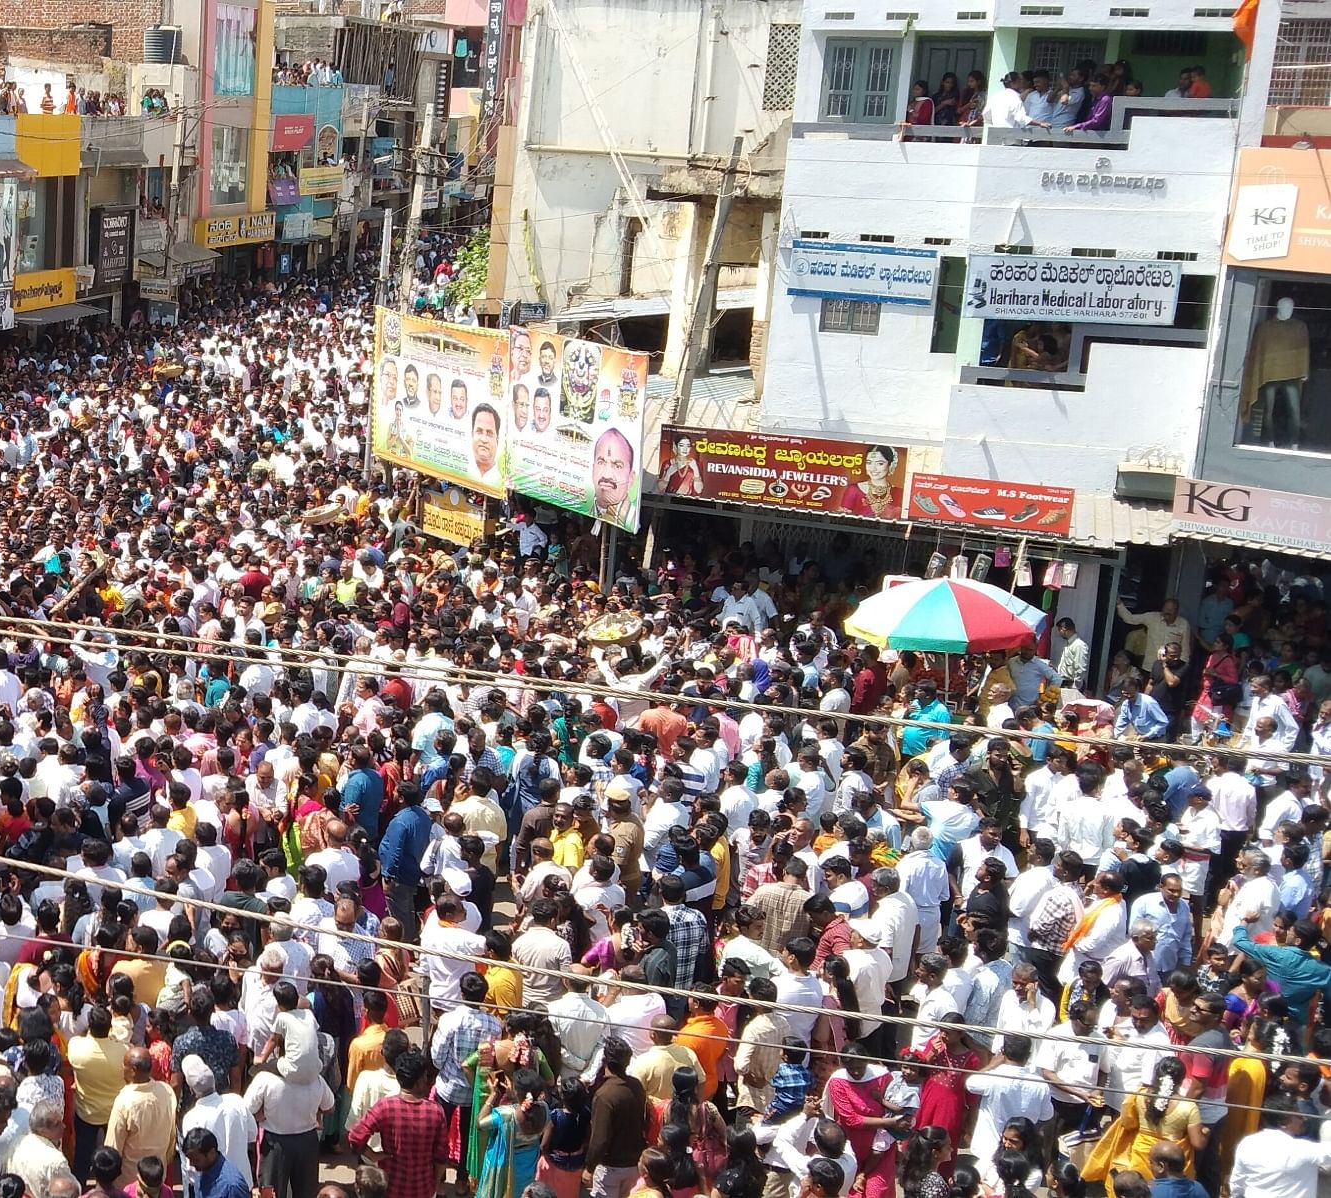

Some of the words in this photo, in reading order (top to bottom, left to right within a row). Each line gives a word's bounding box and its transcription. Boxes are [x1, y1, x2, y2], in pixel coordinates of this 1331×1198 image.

[1250, 206, 1287, 226] KG
[1247, 234, 1268, 245] TIME
[1271, 231, 1284, 240] TO
[810, 260, 837, 275] ಹರಿಹರ
[990, 260, 1037, 282] ಹರಿಹರ
[1040, 262, 1095, 284] ಮೆಡಿಕಲ್
[989, 288, 1040, 306] Harihara
[1041, 289, 1086, 308] Medical
[995, 307, 1036, 316] SHIMOGA
[1039, 308, 1070, 316] CIRCLE
[707, 462, 778, 480] REVANSIDDA
[780, 469, 848, 487] JEWELLER'S
[997, 488, 1017, 498] M.S
[1019, 491, 1070, 503] Footwear
[1177, 481, 1253, 521] KG
[1178, 521, 1233, 536] SHIVAMOGA
[1250, 514, 1318, 538] KAVERI
